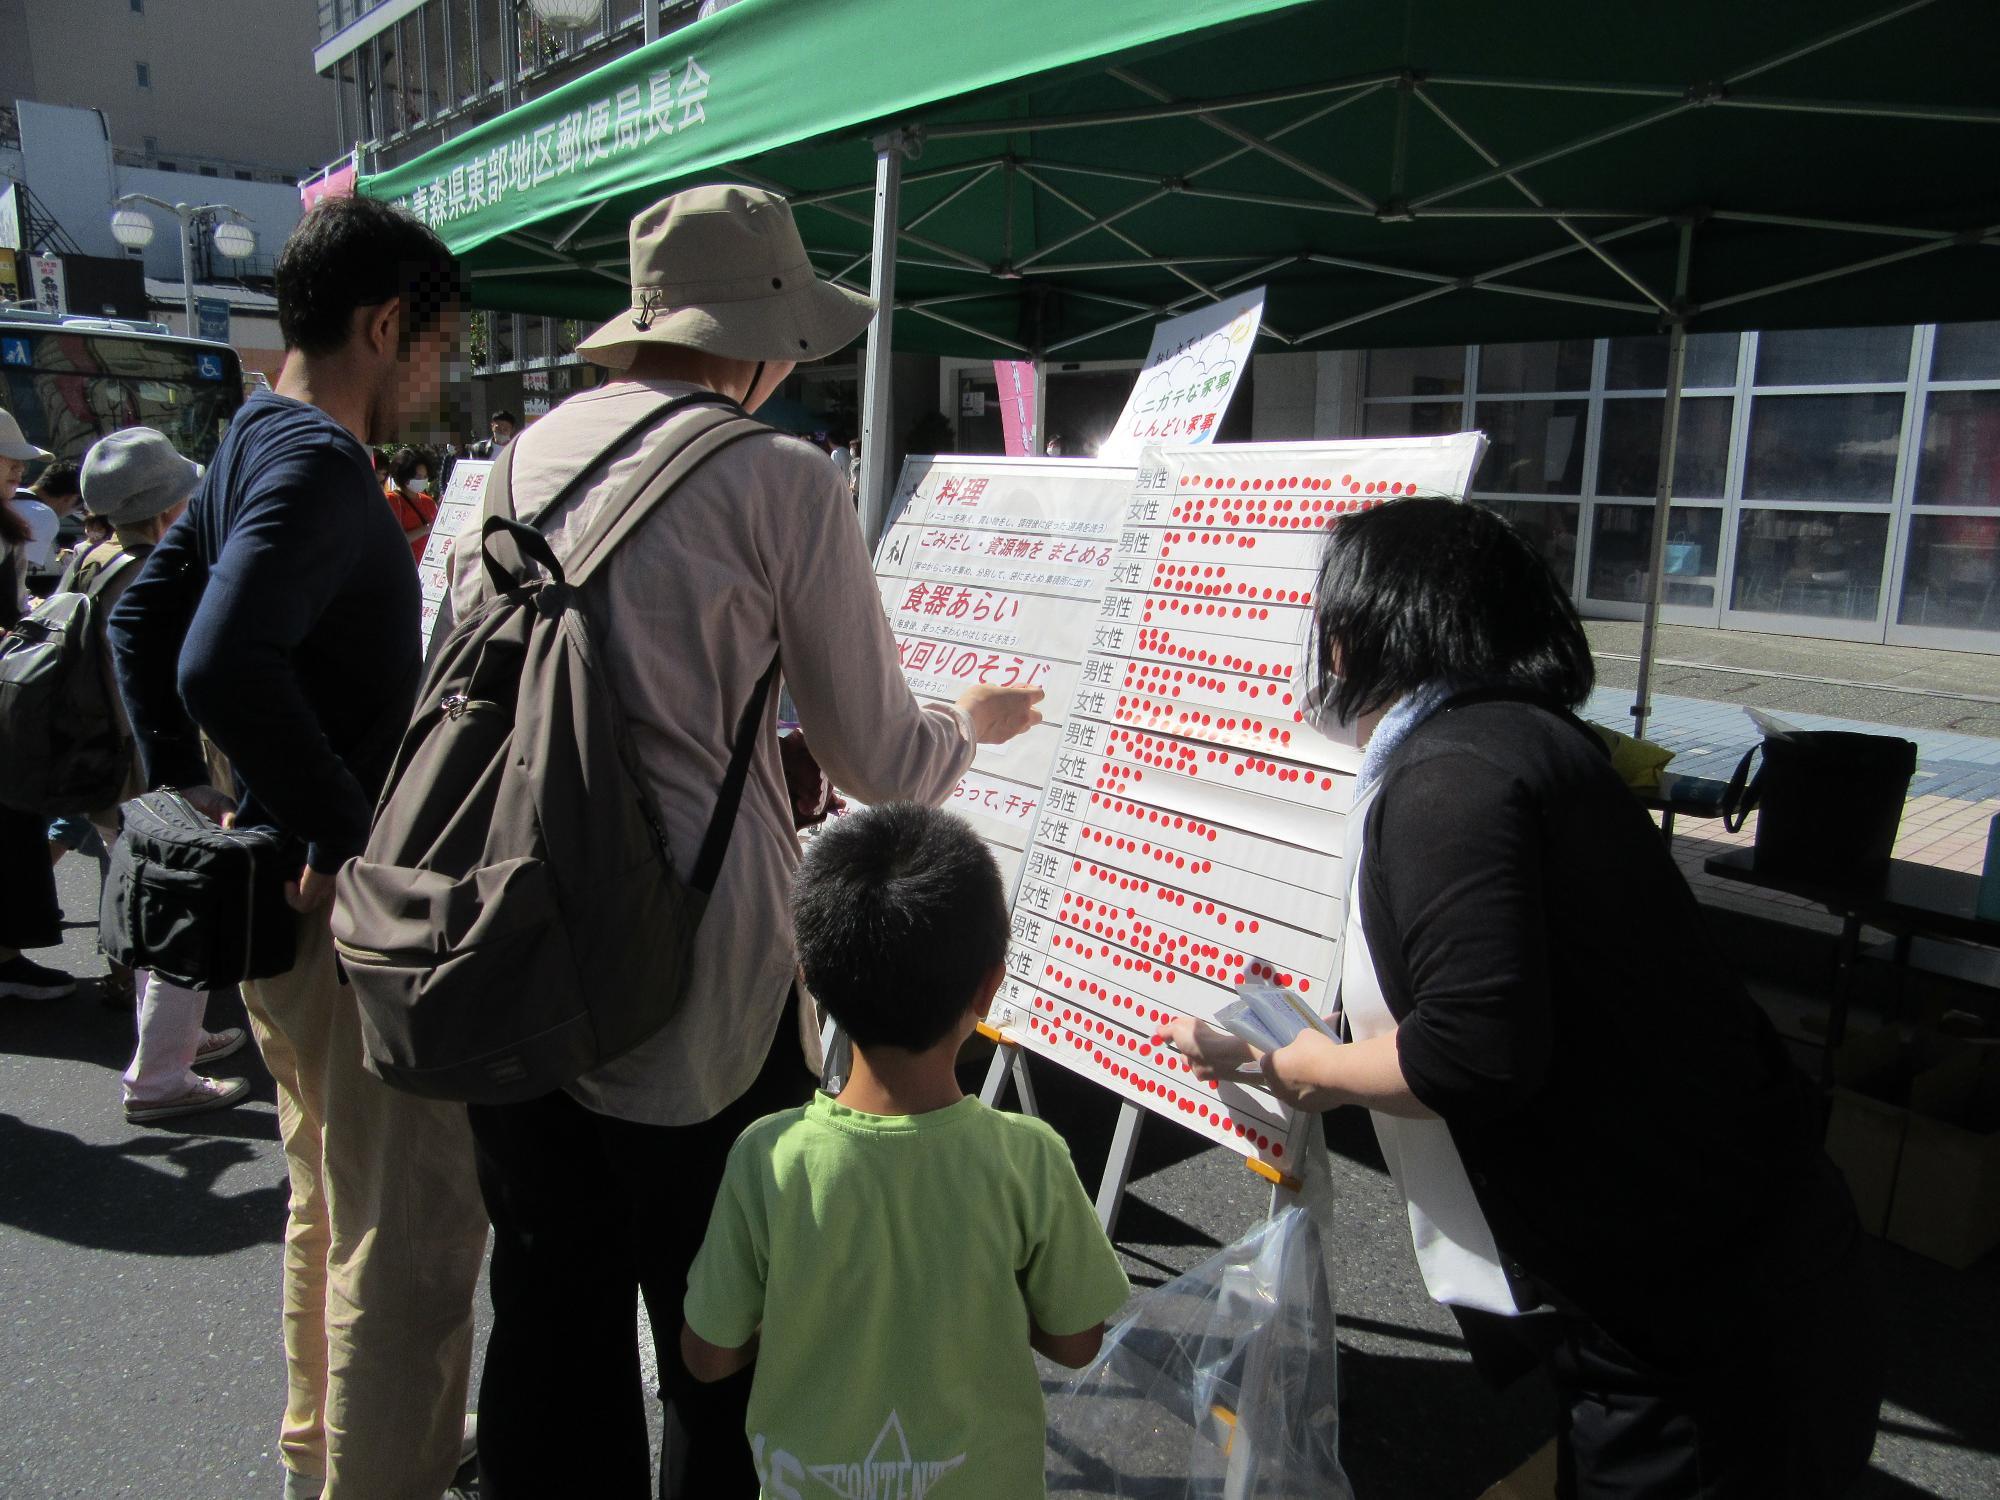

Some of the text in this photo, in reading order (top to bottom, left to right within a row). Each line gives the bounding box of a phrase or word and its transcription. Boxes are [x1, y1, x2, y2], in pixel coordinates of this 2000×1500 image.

[1141, 370, 1232, 413] ニガテな家事
[1133, 412, 1217, 437] しんどい家事
[1136, 467, 1168, 489] 男性
[936, 476, 989, 507] 料理
[1127, 500, 1160, 521] 女性
[920, 531, 1113, 566] ごみだし・資源物を まとめる
[1118, 532, 1150, 554] 男性
[1110, 562, 1142, 584] 女性
[901, 581, 1019, 622] 食器あらい
[1101, 595, 1133, 618] 男性
[1092, 626, 1124, 649] 女性
[1083, 659, 1114, 684] 男性
[1074, 690, 1106, 714] 女性
[1065, 722, 1096, 748] 男性
[1056, 753, 1087, 779] 女性
[1046, 786, 1078, 813] 男性
[1038, 817, 1070, 844] 女性
[1028, 851, 1059, 879] 男性
[1020, 881, 1051, 911] 女性
[1011, 914, 1041, 944] 男性
[1004, 946, 1033, 976] 女性
